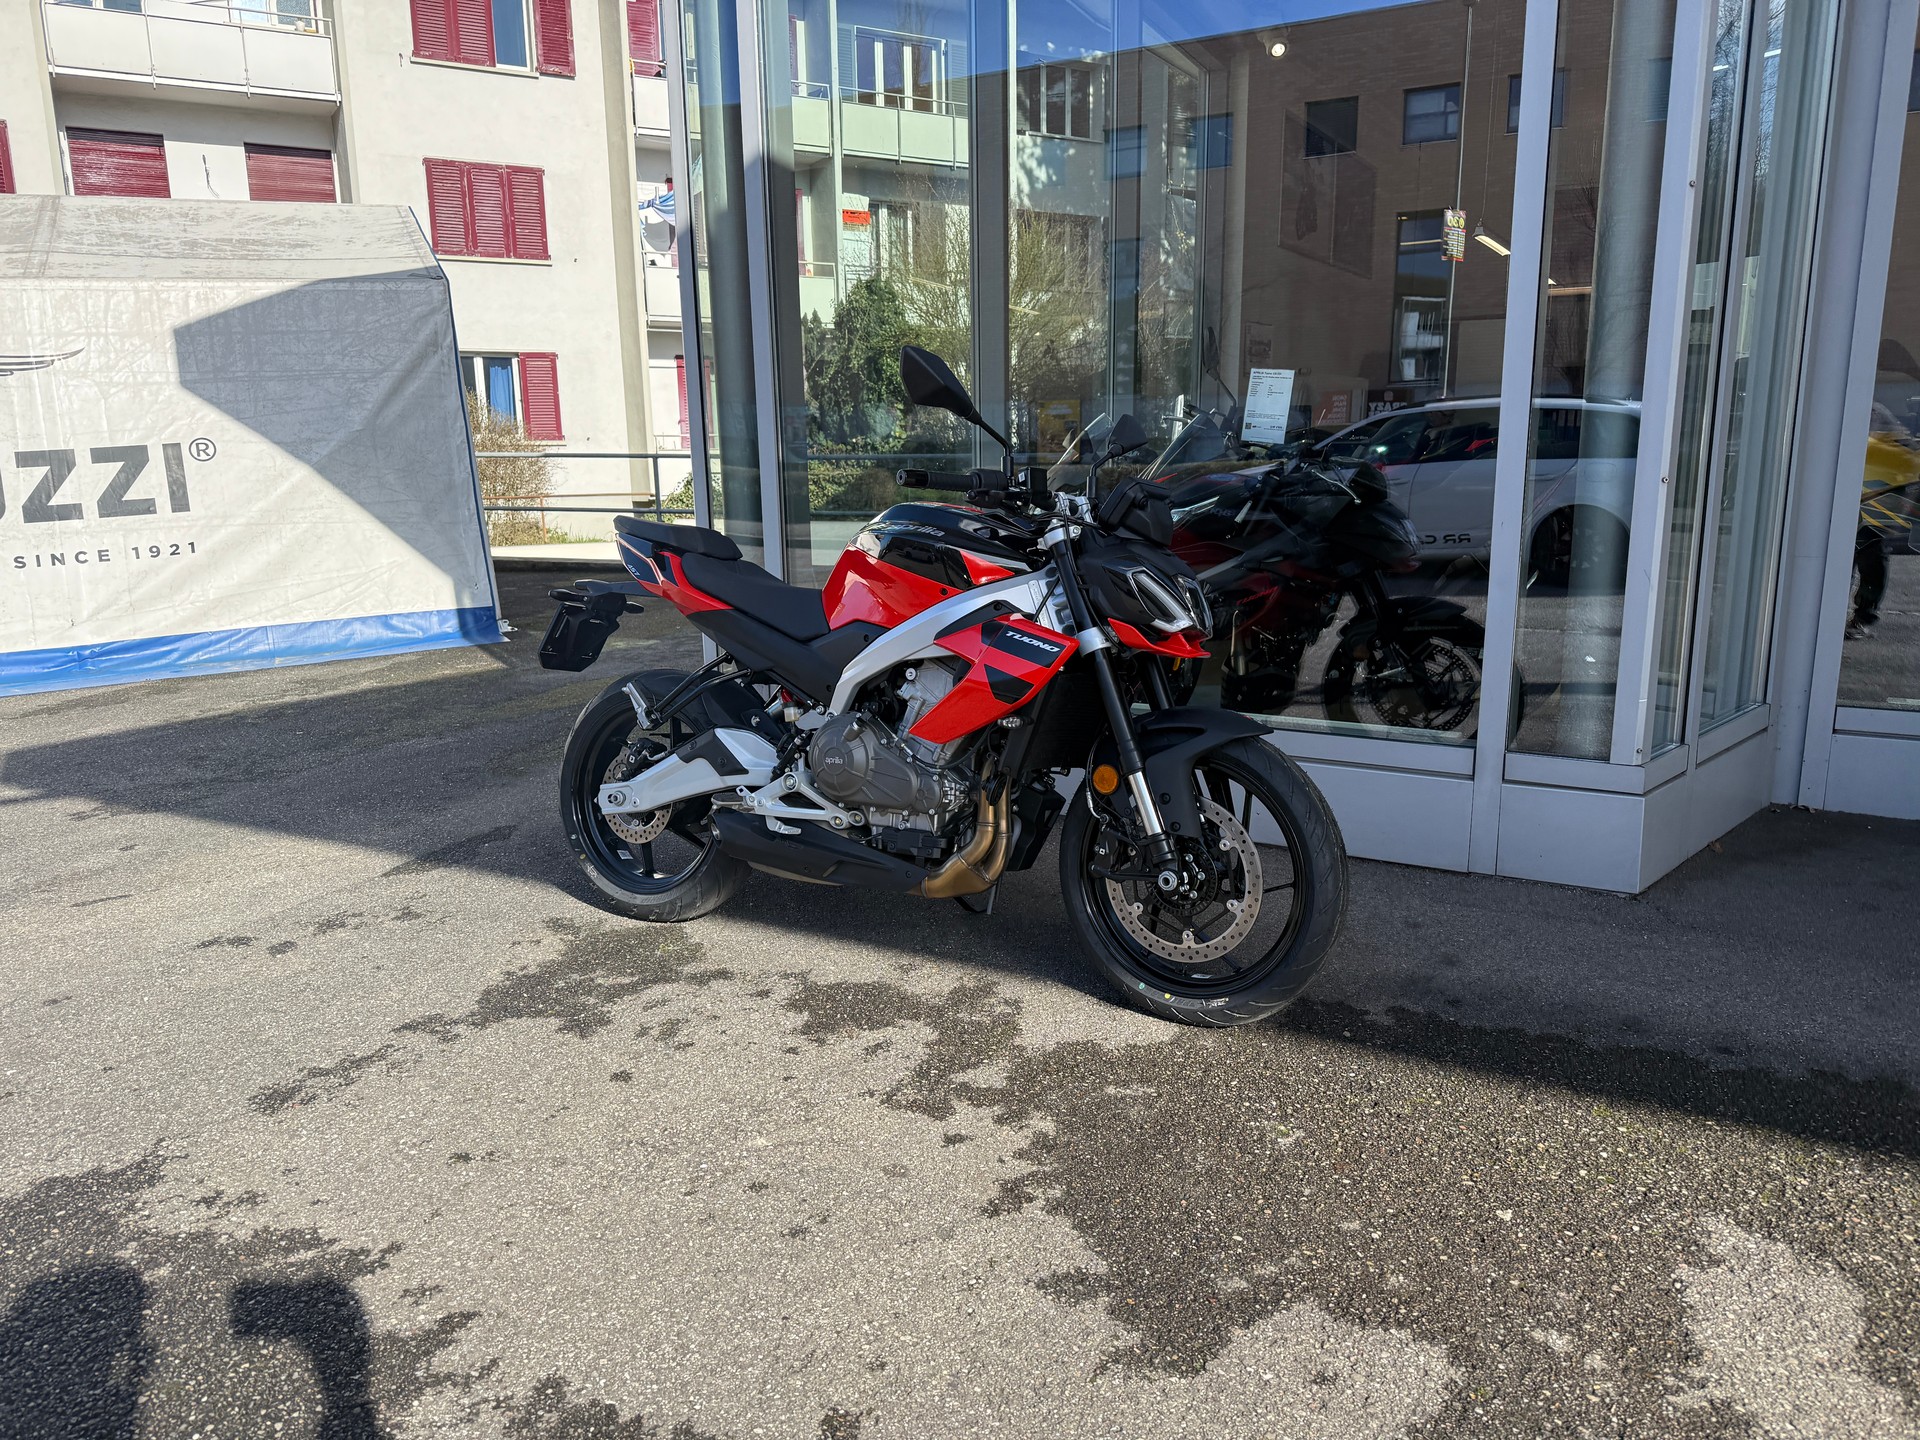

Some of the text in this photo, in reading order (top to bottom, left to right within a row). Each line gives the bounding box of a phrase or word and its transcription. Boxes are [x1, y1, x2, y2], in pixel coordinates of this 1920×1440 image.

[14, 541, 198, 570] SINCE 1921
[1005, 630, 1061, 653] TUONO
[825, 756, 843, 765] aprilia
